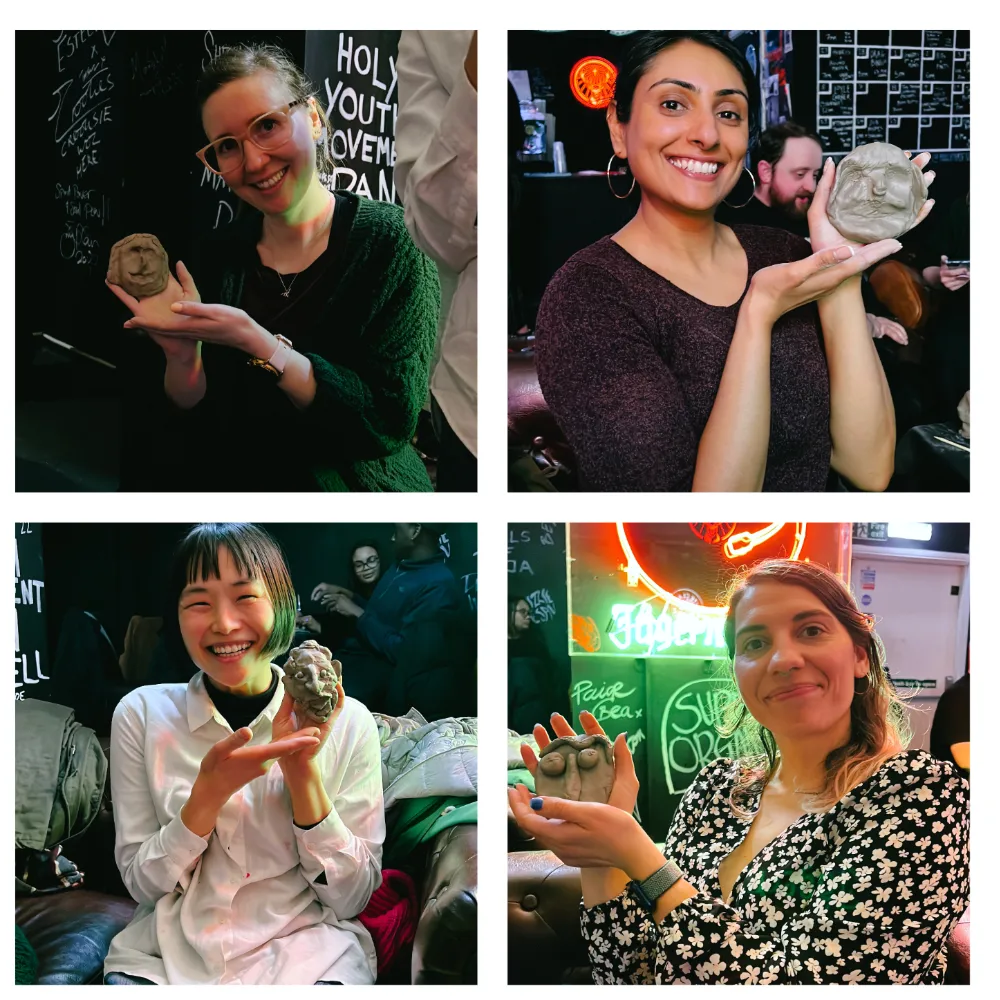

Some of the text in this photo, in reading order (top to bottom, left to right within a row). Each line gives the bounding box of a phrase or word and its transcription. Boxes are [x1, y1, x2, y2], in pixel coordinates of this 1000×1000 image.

[337, 32, 398, 104] HOLY
[76, 150, 99, 179] HERE
[571, 679, 636, 705] Paige
